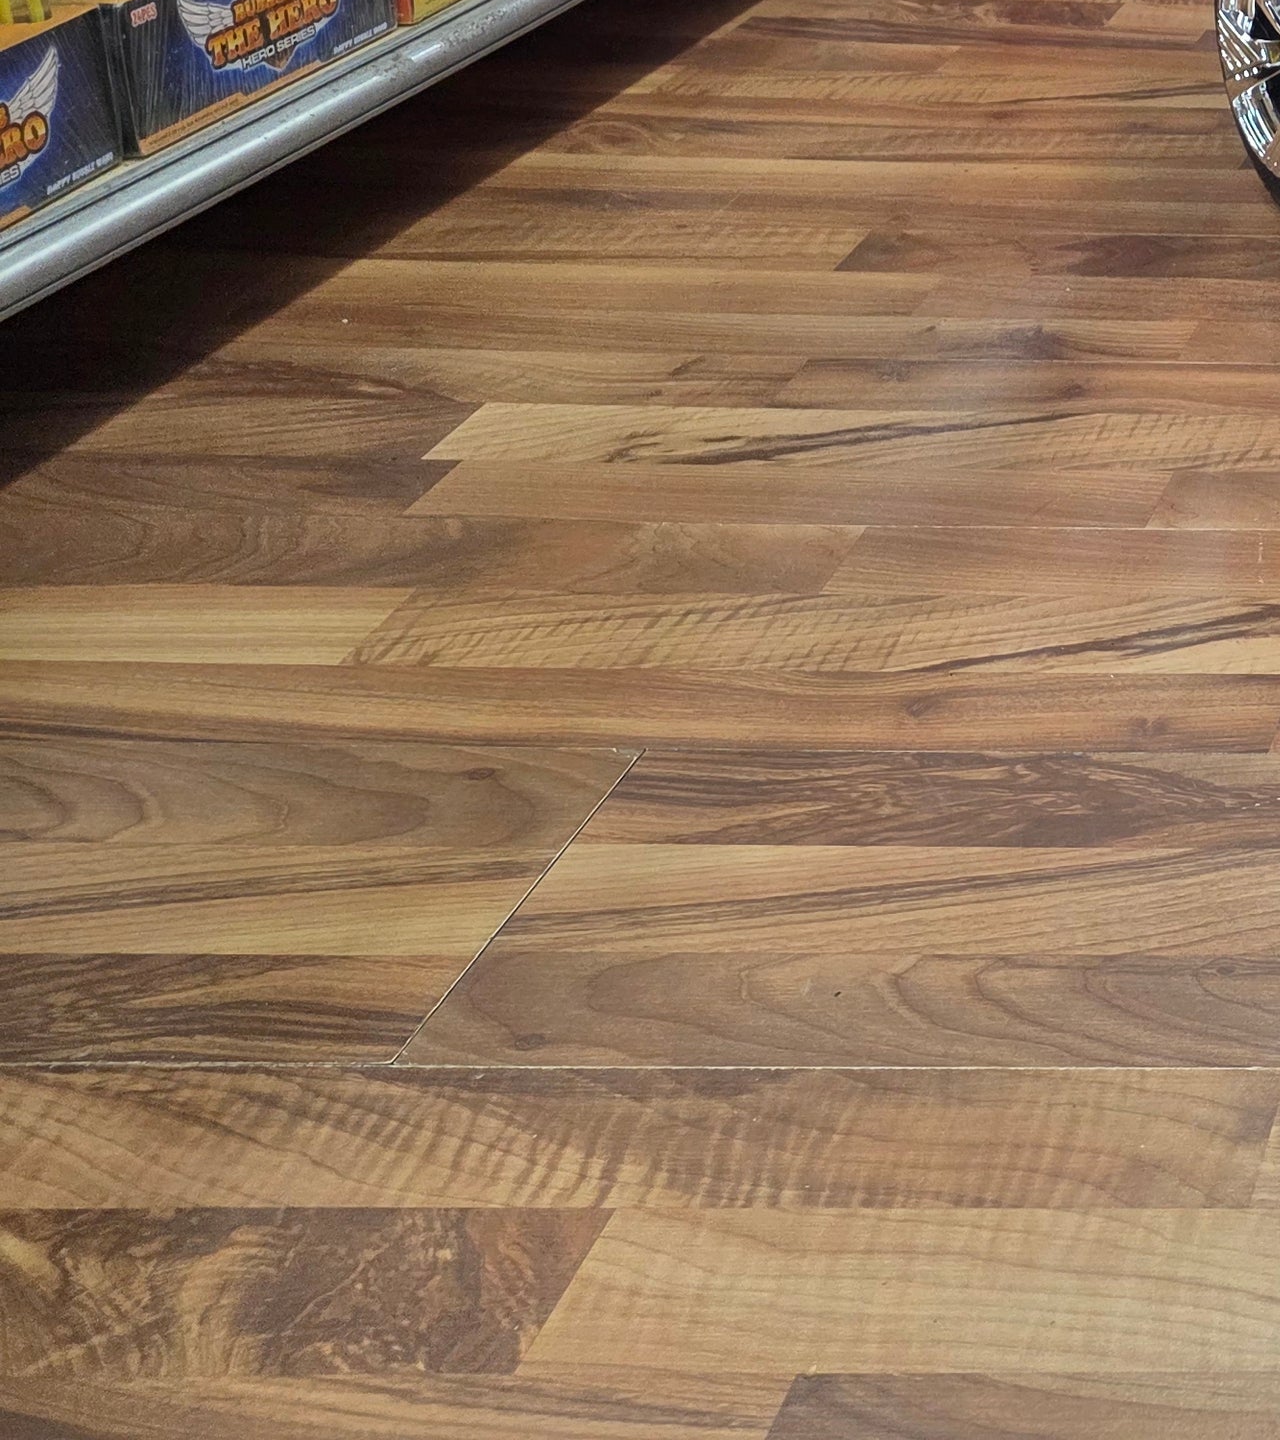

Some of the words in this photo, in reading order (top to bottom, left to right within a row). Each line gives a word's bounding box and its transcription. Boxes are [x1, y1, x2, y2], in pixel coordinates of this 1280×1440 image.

[208, 17, 266, 67] THE
[242, 43, 276, 70] HERO
[276, 26, 317, 54] SERIES
[0, 111, 48, 167] RO
